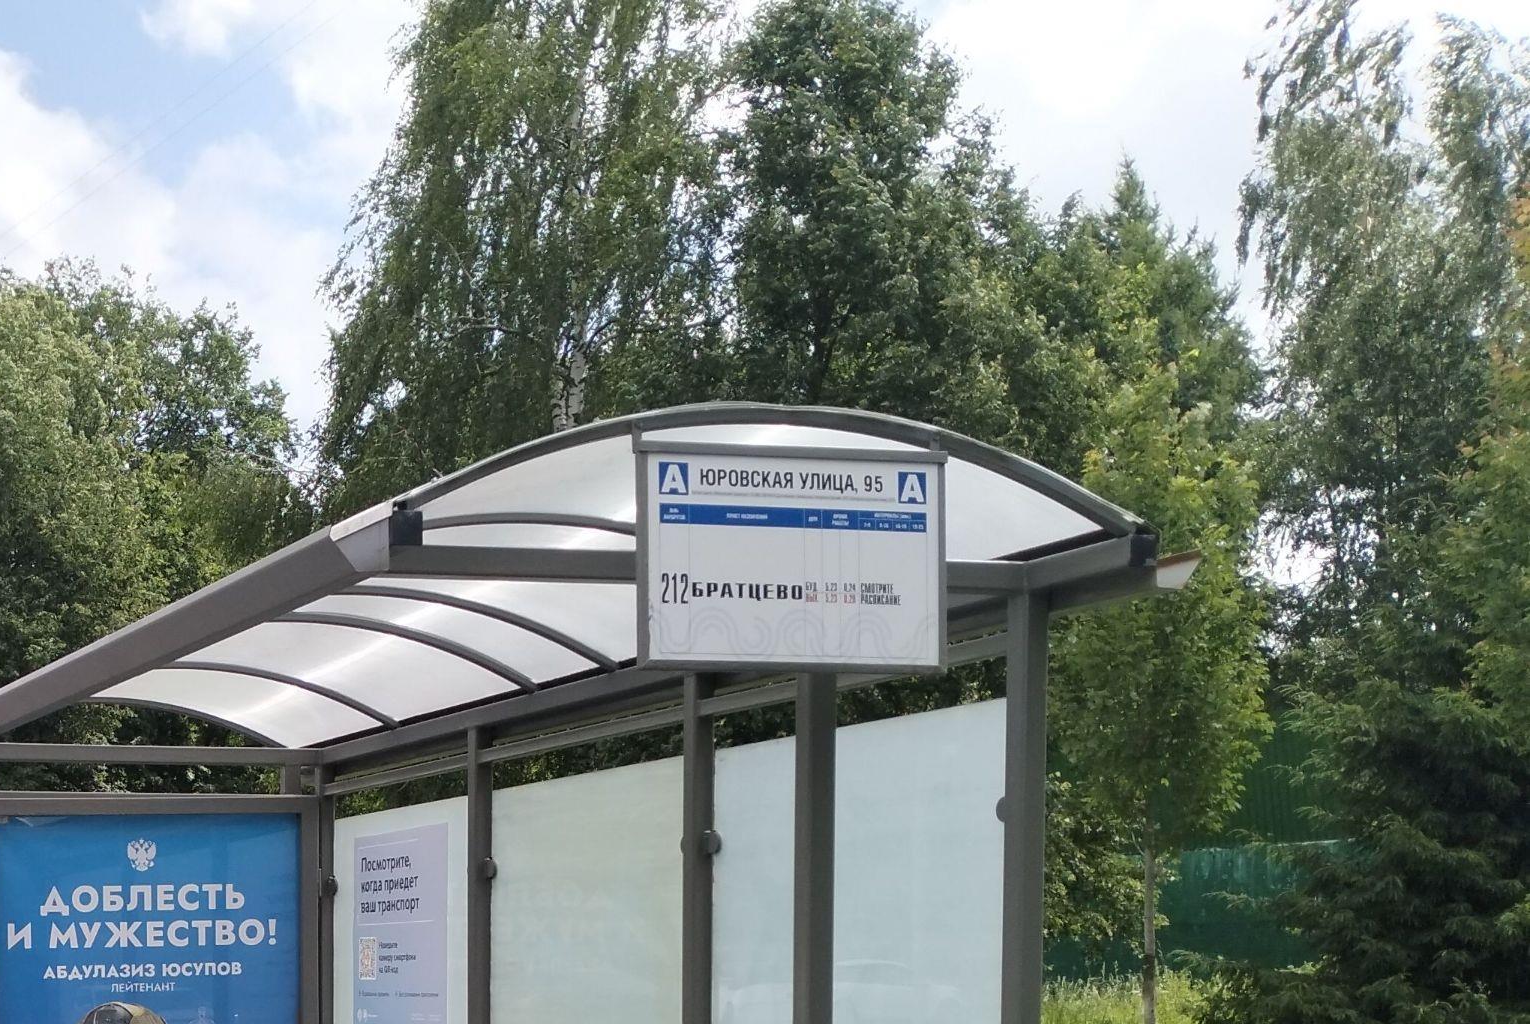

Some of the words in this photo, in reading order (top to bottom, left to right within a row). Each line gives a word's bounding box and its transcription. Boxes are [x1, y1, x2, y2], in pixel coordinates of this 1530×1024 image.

[700, 468, 793, 489] ЮРОВСКАЯ
[800, 472, 858, 493] УЛИЦА,
[864, 476, 883, 493] 95
[661, 573, 689, 605] 212
[692, 581, 803, 601] БРАТЦЕВО
[860, 583, 894, 594] СМОТРИТЕ
[360, 854, 412, 873] Посмотрите,
[360, 880, 383, 895] когда
[384, 874, 419, 893] приедет
[39, 883, 246, 917] ДОБЛЕСТЬ
[360, 899, 376, 914] ваш
[376, 897, 420, 916] транспорт
[7, 923, 32, 950] И
[48, 918, 277, 949] МУЖЕСТВО!
[43, 963, 156, 981] АБДУЛАЗИЗ
[161, 962, 243, 978] ЮСУПОВ
[110, 982, 176, 993] ЛЕЙТЕНАНТ
